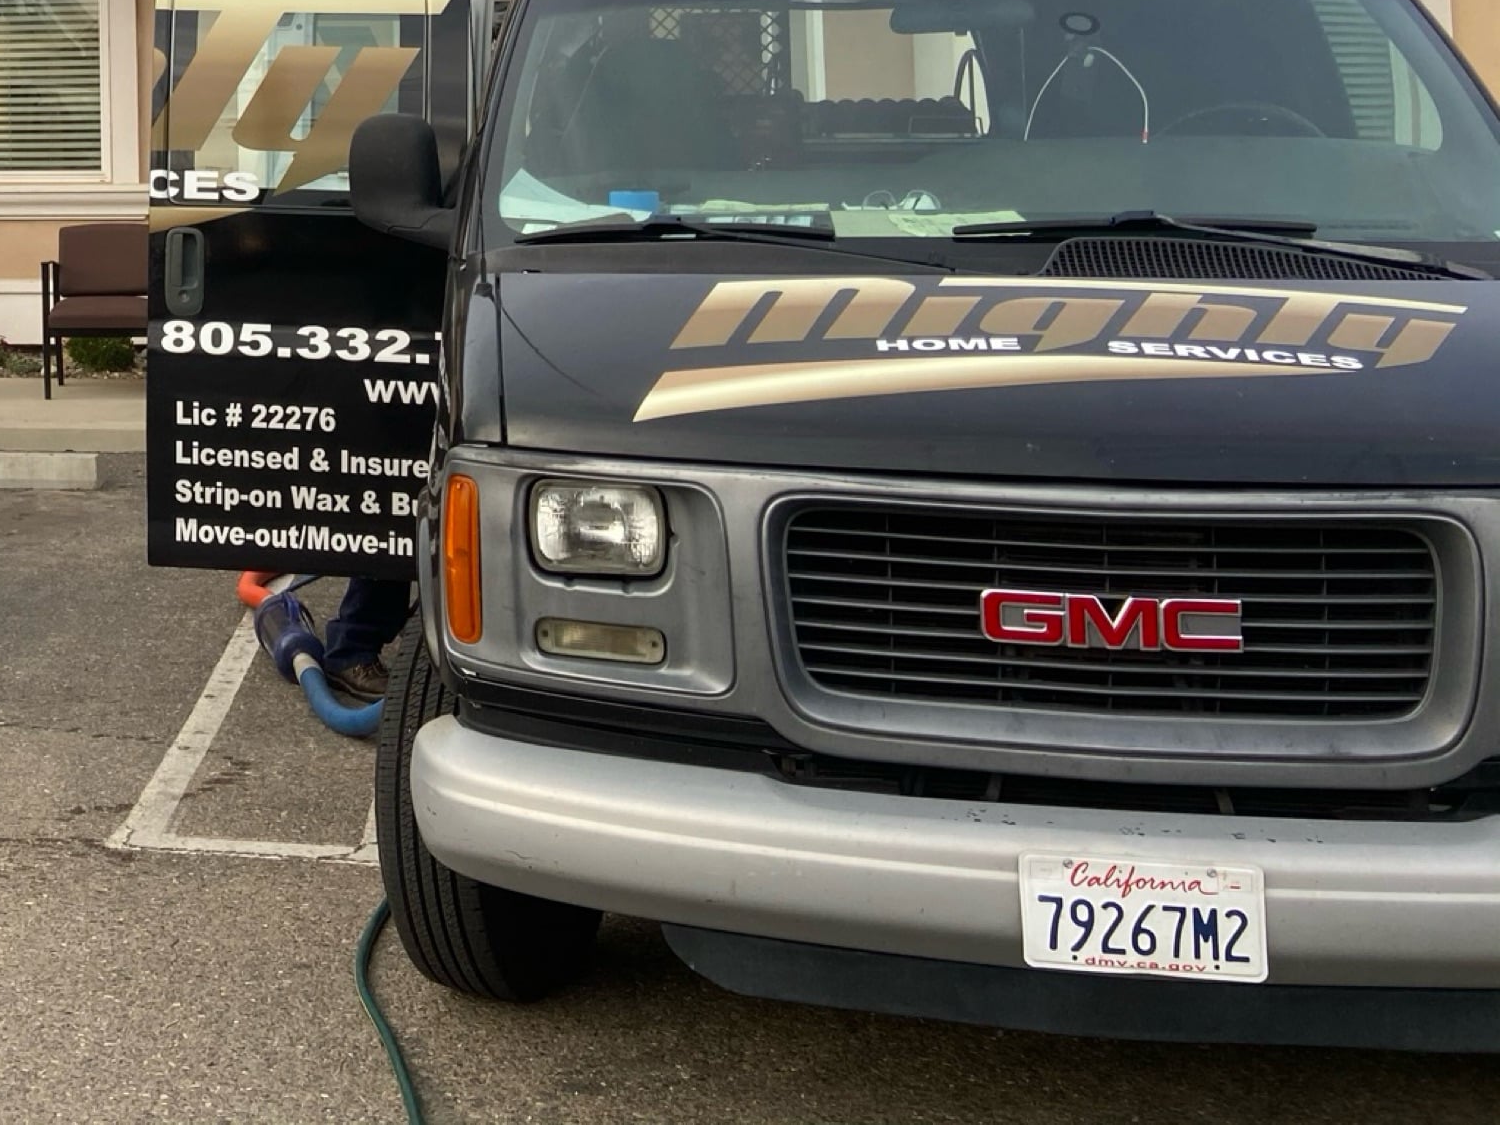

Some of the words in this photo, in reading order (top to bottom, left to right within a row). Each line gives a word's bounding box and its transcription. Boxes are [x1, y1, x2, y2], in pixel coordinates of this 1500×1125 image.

[160, 320, 442, 365] 805.332.
[876, 336, 1021, 353] HOME
[1108, 340, 1364, 370] SERVICES
[176, 400, 217, 426] Lic
[226, 403, 242, 427] #
[251, 403, 336, 432] 22276
[175, 440, 299, 471] Licensed
[310, 448, 330, 472] &
[175, 479, 282, 511] Strip-on
[291, 485, 350, 513] Wax
[361, 490, 381, 515] &
[175, 517, 413, 557] Move-out/Move-in
[980, 588, 1244, 653] GMC
[1069, 861, 1219, 898] California
[1037, 894, 1250, 963] 79267M2
[1085, 956, 1206, 972] dmv.ca.gov
